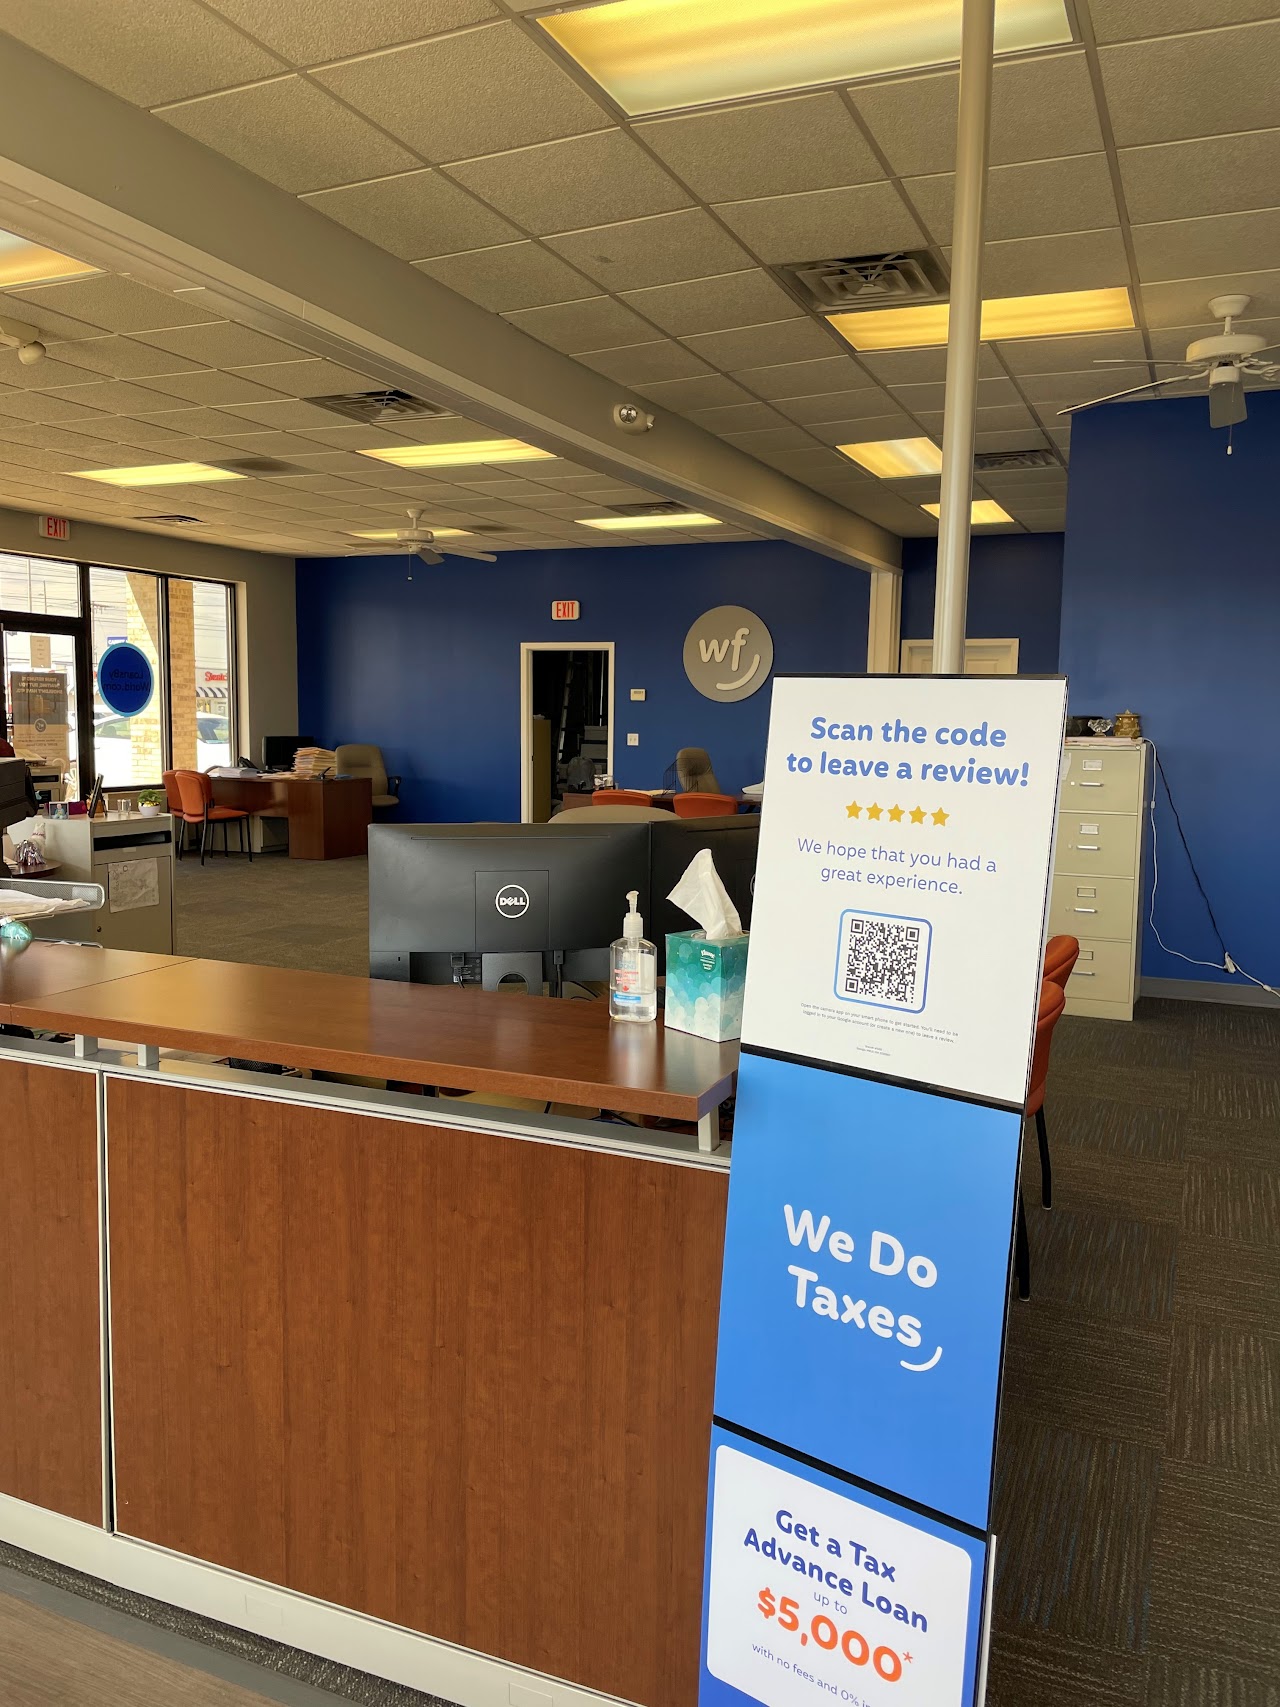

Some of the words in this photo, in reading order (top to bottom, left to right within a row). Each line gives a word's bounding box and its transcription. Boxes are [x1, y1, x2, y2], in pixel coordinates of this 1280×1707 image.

[48, 517, 66, 538] EXIT
[556, 602, 575, 618] EXIT
[699, 628, 749, 672] wf
[810, 717, 873, 741] Scan
[881, 719, 927, 744] the
[935, 721, 1007, 747] code
[787, 753, 813, 773] to
[820, 751, 889, 778] leave
[896, 762, 912, 779] a
[921, 758, 1029, 787] review!
[798, 838, 822, 853] We
[826, 840, 866, 860] hope
[871, 846, 905, 863] that
[910, 853, 941, 868] you
[947, 852, 981, 871] had
[986, 861, 997, 873] a
[821, 868, 862, 882] great
[867, 872, 963, 894] experience.
[500, 896, 525, 906] DELL
[784, 1204, 854, 1263] We
[870, 1231, 938, 1288] Do
[788, 1264, 922, 1348] Taxes
[776, 1510, 819, 1547] Get
[826, 1537, 842, 1558] a
[849, 1540, 896, 1582] Tax
[744, 1528, 853, 1597] Advance
[862, 1581, 927, 1633] Loan
[813, 1591, 829, 1607] up
[834, 1600, 848, 1615] to
[752, 1643, 774, 1661] with
[777, 1657, 790, 1669] no
[793, 1664, 814, 1683] fees
[816, 1677, 838, 1696] and
[841, 1690, 859, 1707] 0%
